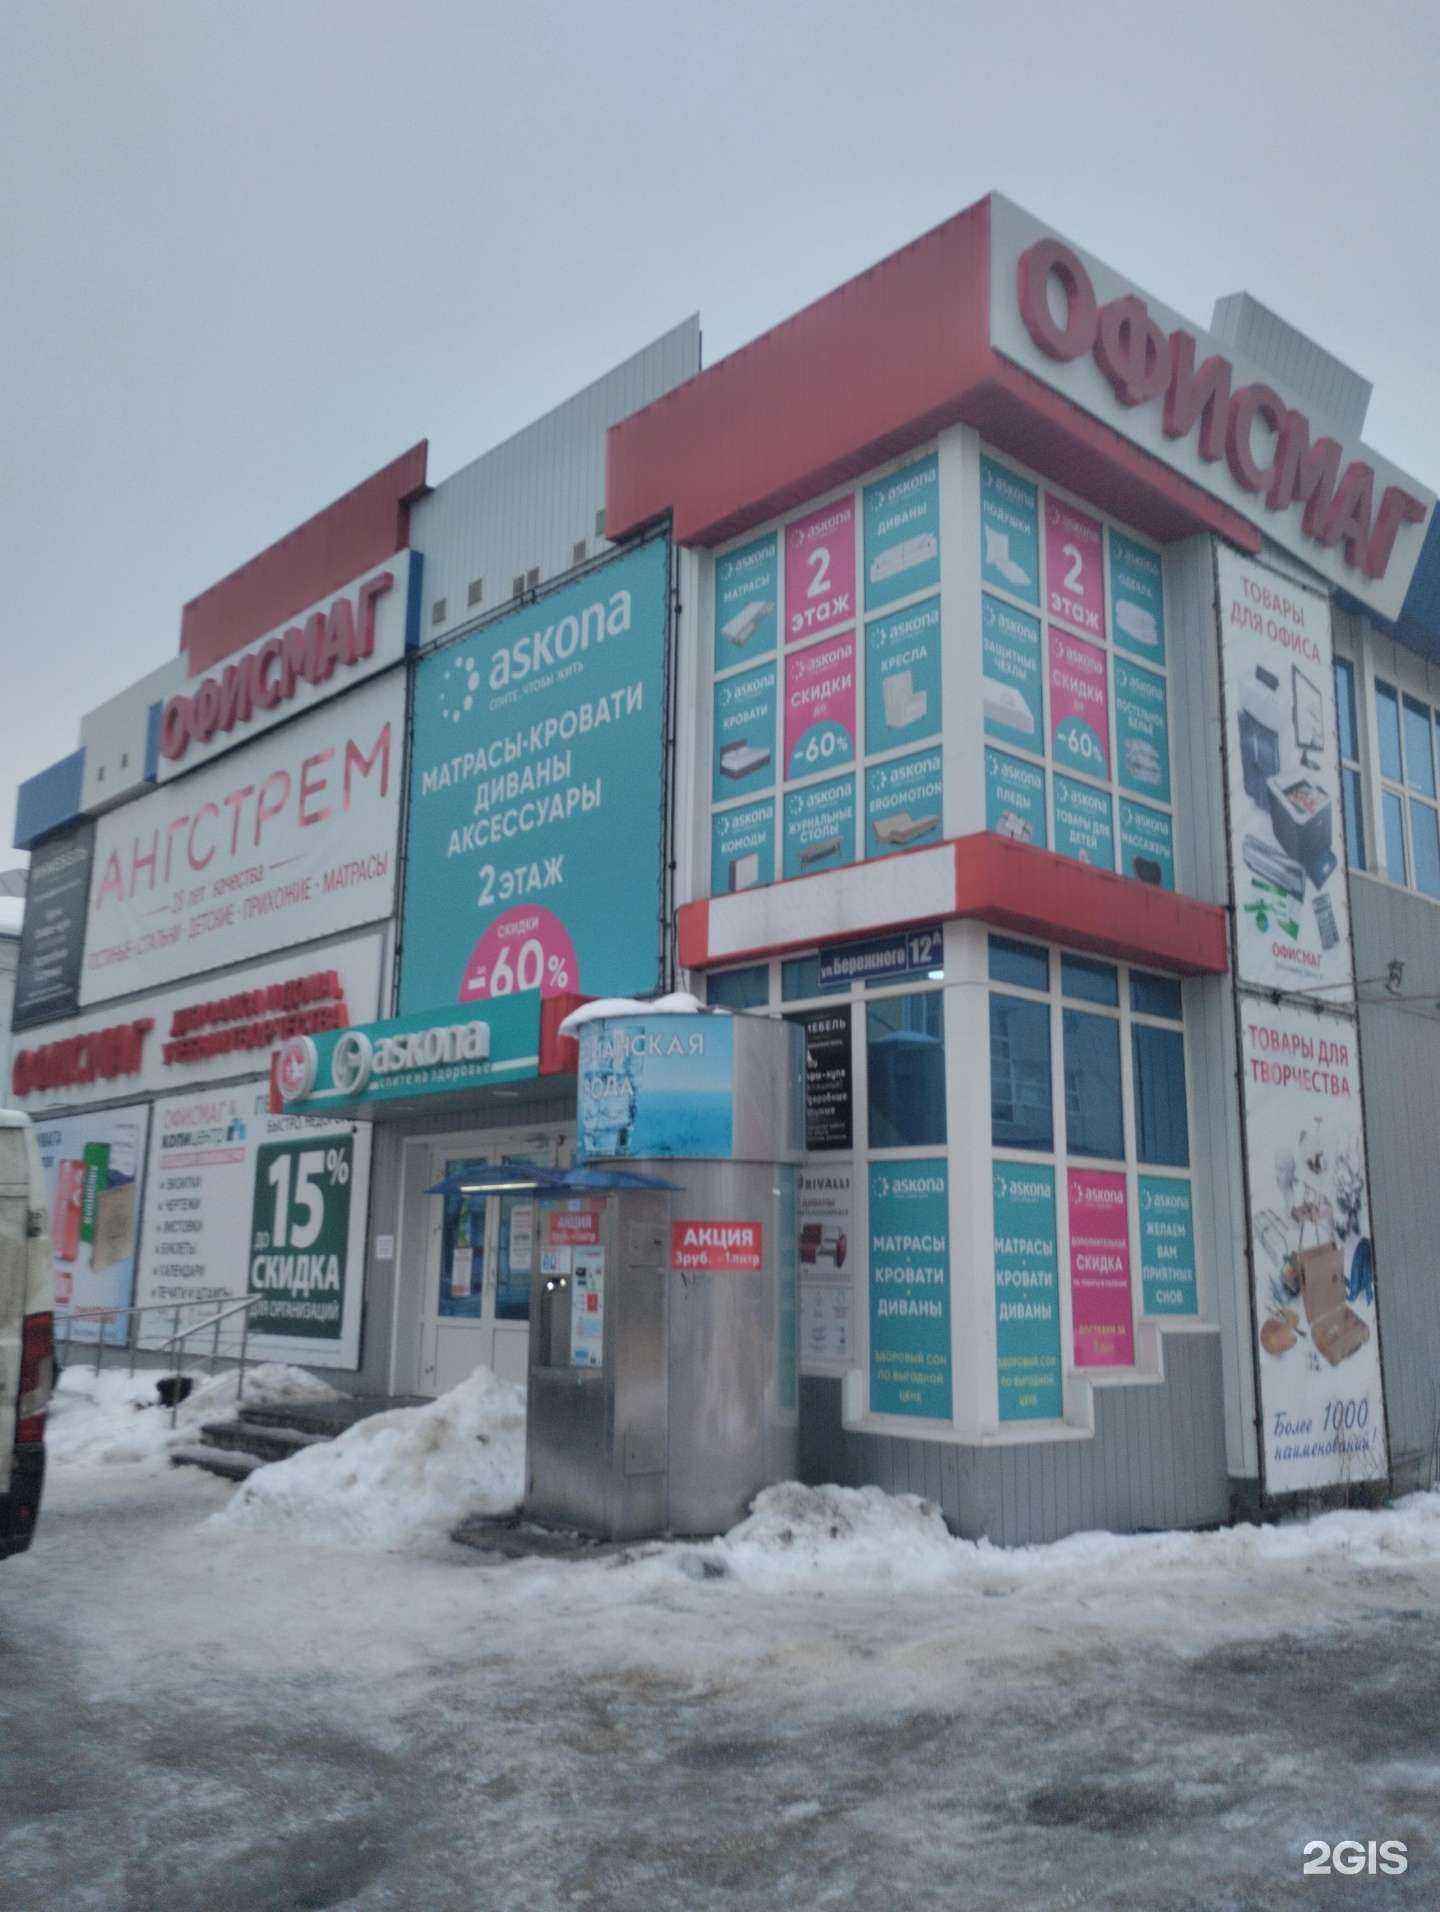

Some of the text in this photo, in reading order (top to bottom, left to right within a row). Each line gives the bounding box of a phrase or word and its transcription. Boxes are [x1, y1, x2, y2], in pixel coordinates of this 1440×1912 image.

[1016, 237, 1427, 579] ОФИСМАГ
[877, 503, 927, 536] ДИВАНЫ
[807, 547, 832, 598] 2
[1063, 543, 1084, 596] 2
[723, 574, 771, 602] МАТРАСЫ
[1243, 577, 1304, 627] ТОВАРЫ
[490, 589, 632, 690] askona
[1230, 602, 1320, 664] ДЛЯ ОФИСА
[159, 571, 394, 762] ОФИСМАГ
[880, 644, 928, 672] КРЕСЛА
[722, 704, 768, 729] КРОВАТИ
[475, 751, 572, 815] ДИВАНЫ
[869, 781, 942, 812] ERGOMOTION
[97, 720, 391, 909] АНГСТРЕМ
[448, 777, 601, 858] АКСЕССУАРЫ
[721, 832, 767, 853] КОМОДЫ
[322, 852, 389, 894] МАТРАСЫ
[478, 854, 564, 906] 2 ЭТАЖ
[1272, 942, 1323, 968] ОФИСМАГ
[372, 1021, 490, 1075] askona
[1248, 1024, 1349, 1068] ТОВАРЫ ДЛЯ
[1250, 1058, 1350, 1097] ТВОРЧЕСТВА
[893, 1177, 944, 1193] askona
[1009, 1179, 1051, 1199] askona
[1085, 1185, 1123, 1205] askona
[683, 1228, 754, 1249] АКЦИЯ
[872, 1235, 945, 1252] МАТРАСЫ
[1146, 1222, 1186, 1237] ЖЕЛАЕМ
[994, 1236, 1053, 1257] МАТРАСЫ
[1157, 1244, 1177, 1259] ВАМ
[251, 1255, 340, 1298] СКИДКА
[875, 1268, 944, 1285] КРОВАТИ
[1076, 1254, 1123, 1274] СКИДКА
[997, 1270, 1052, 1288] КРОВАТИ
[878, 1299, 942, 1318] ДИВАНЫ
[1000, 1301, 1052, 1322] ДИВАНЫ
[1156, 1290, 1183, 1305] СНОВ
[1274, 1397, 1368, 1437] Более 1000
